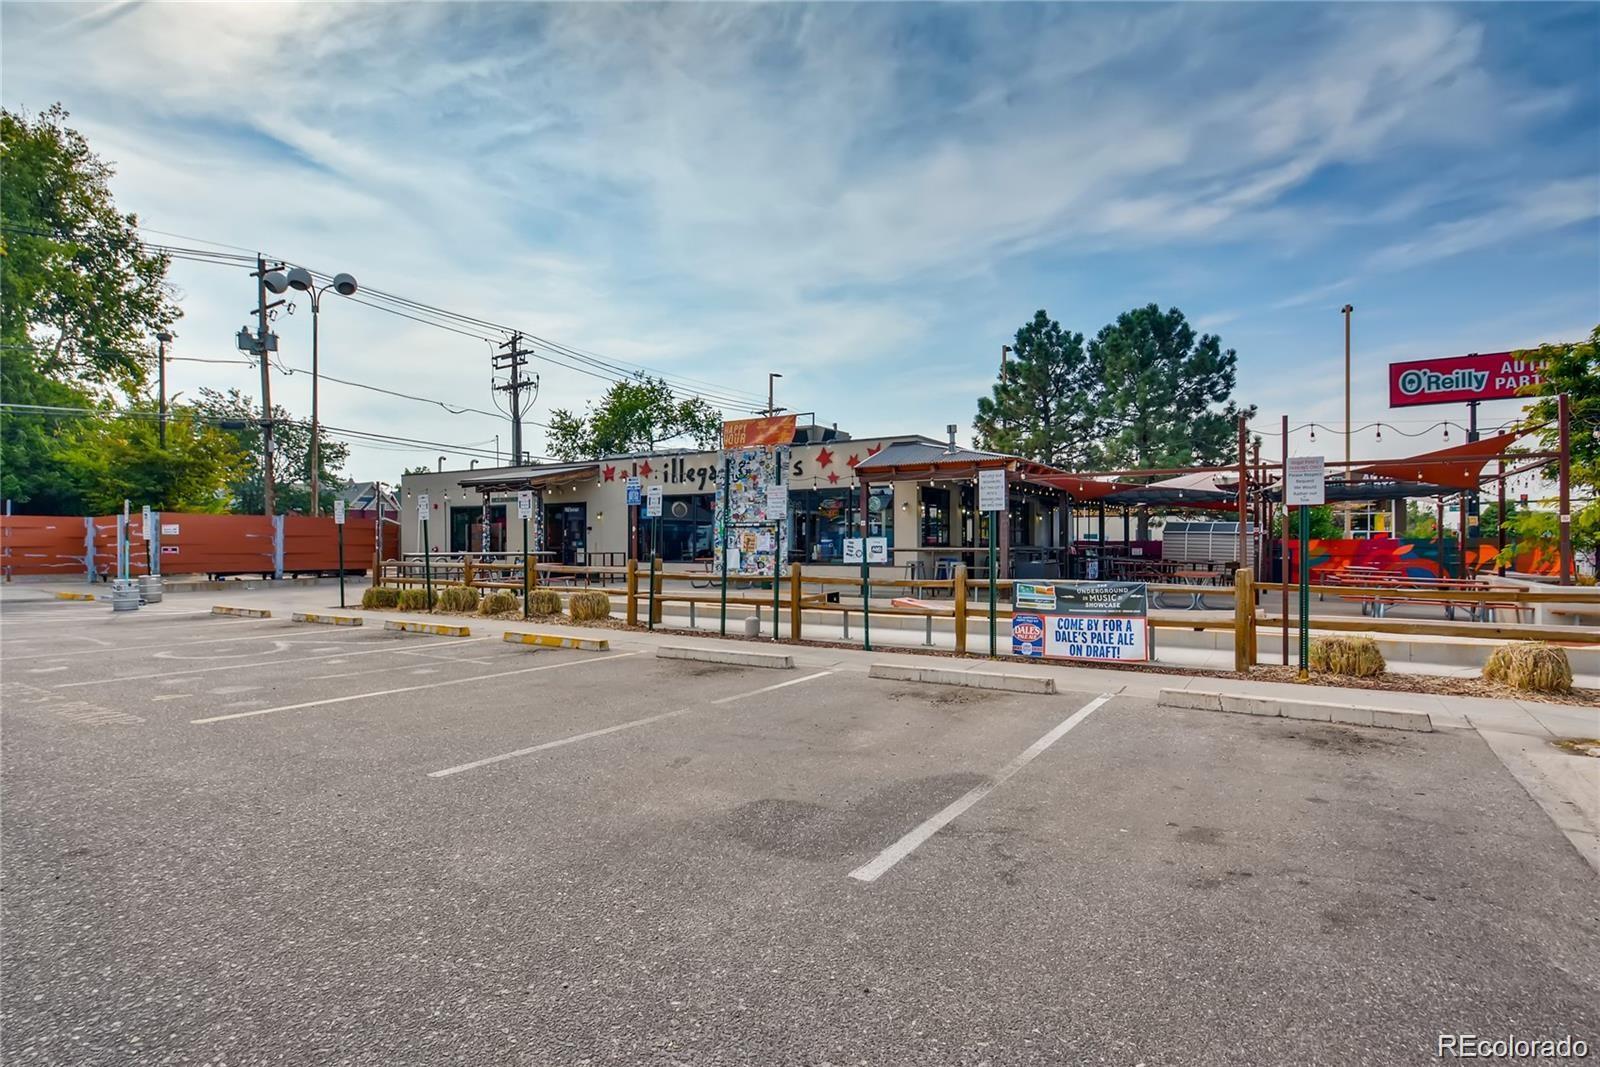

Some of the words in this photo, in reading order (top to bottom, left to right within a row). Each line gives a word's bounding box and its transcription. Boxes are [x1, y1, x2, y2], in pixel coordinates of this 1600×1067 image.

[1400, 368, 1489, 396] O'Reilly
[1495, 373, 1545, 390] PART
[663, 457, 717, 491] illega
[1076, 587, 1129, 595] UNDERGROUND
[1089, 594, 1117, 602] MUSIC
[1057, 618, 1084, 630] COME
[1087, 619, 1099, 631] BY
[1103, 620, 1122, 632] FOR
[1126, 620, 1132, 632] A
[1055, 630, 1088, 644] DALE'S
[1091, 632, 1115, 645] PALE
[1117, 633, 1135, 646] ALE
[1069, 644, 1083, 657] ON
[1086, 645, 1120, 659] DRAFT!
